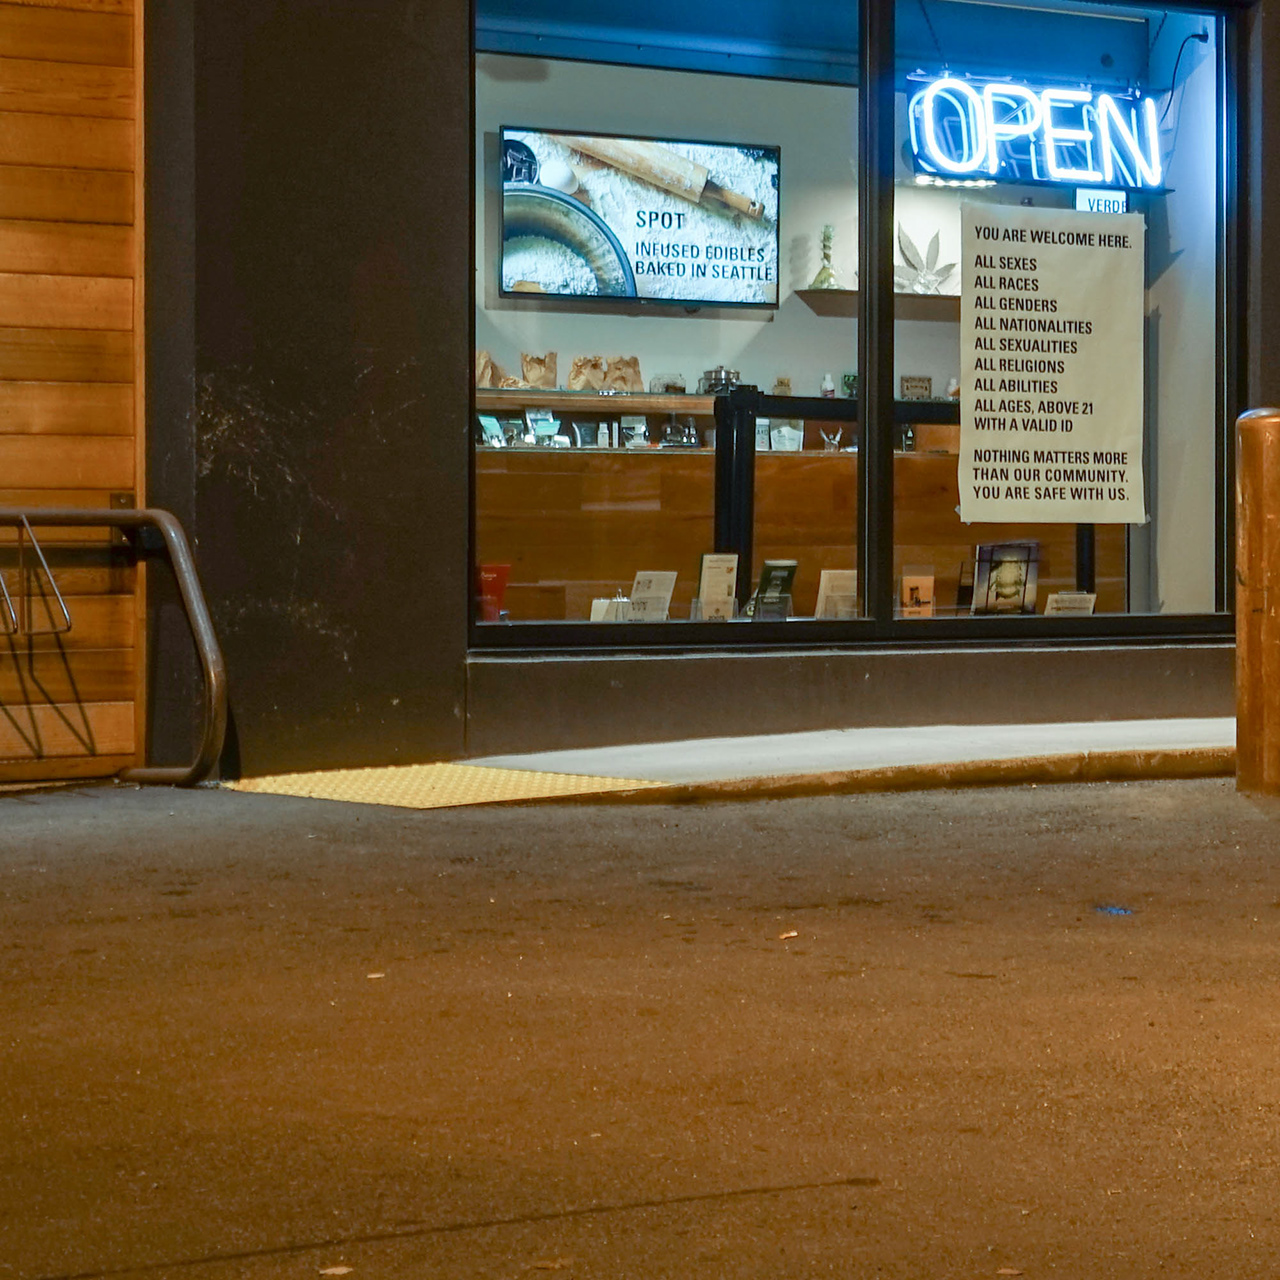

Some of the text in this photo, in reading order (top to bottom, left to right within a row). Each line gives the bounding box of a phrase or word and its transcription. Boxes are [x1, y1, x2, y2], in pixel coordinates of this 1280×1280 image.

[922, 77, 1162, 187] OPEN
[636, 210, 685, 229] SPOT
[975, 226, 1132, 249] YOU ARE WELCOME HERE.
[636, 242, 765, 262] INFUSED EDIBLES
[635, 261, 772, 281] BAKED IN SEATTLE
[975, 255, 1037, 271] ALL SEXES
[975, 276, 1039, 291] ALL RACES
[975, 296, 1057, 312] ALL GENDERS
[975, 317, 1092, 334] ALL NATIONALITIES
[975, 337, 1078, 354] ALL SEXUALITIES
[975, 357, 1065, 374] ALL RELIGIONS
[975, 378, 1058, 394] ALL ABILITIES
[975, 399, 1093, 415] ALL AGES, ABOVE 21
[974, 417, 1073, 432] WITH A VALID ID
[973, 449, 1128, 465] NOTHING MATTERS MORE
[973, 468, 1129, 483] THAN OUR COMMUNITY.
[973, 486, 1129, 501] YOU ARE SAFE WITH US.
